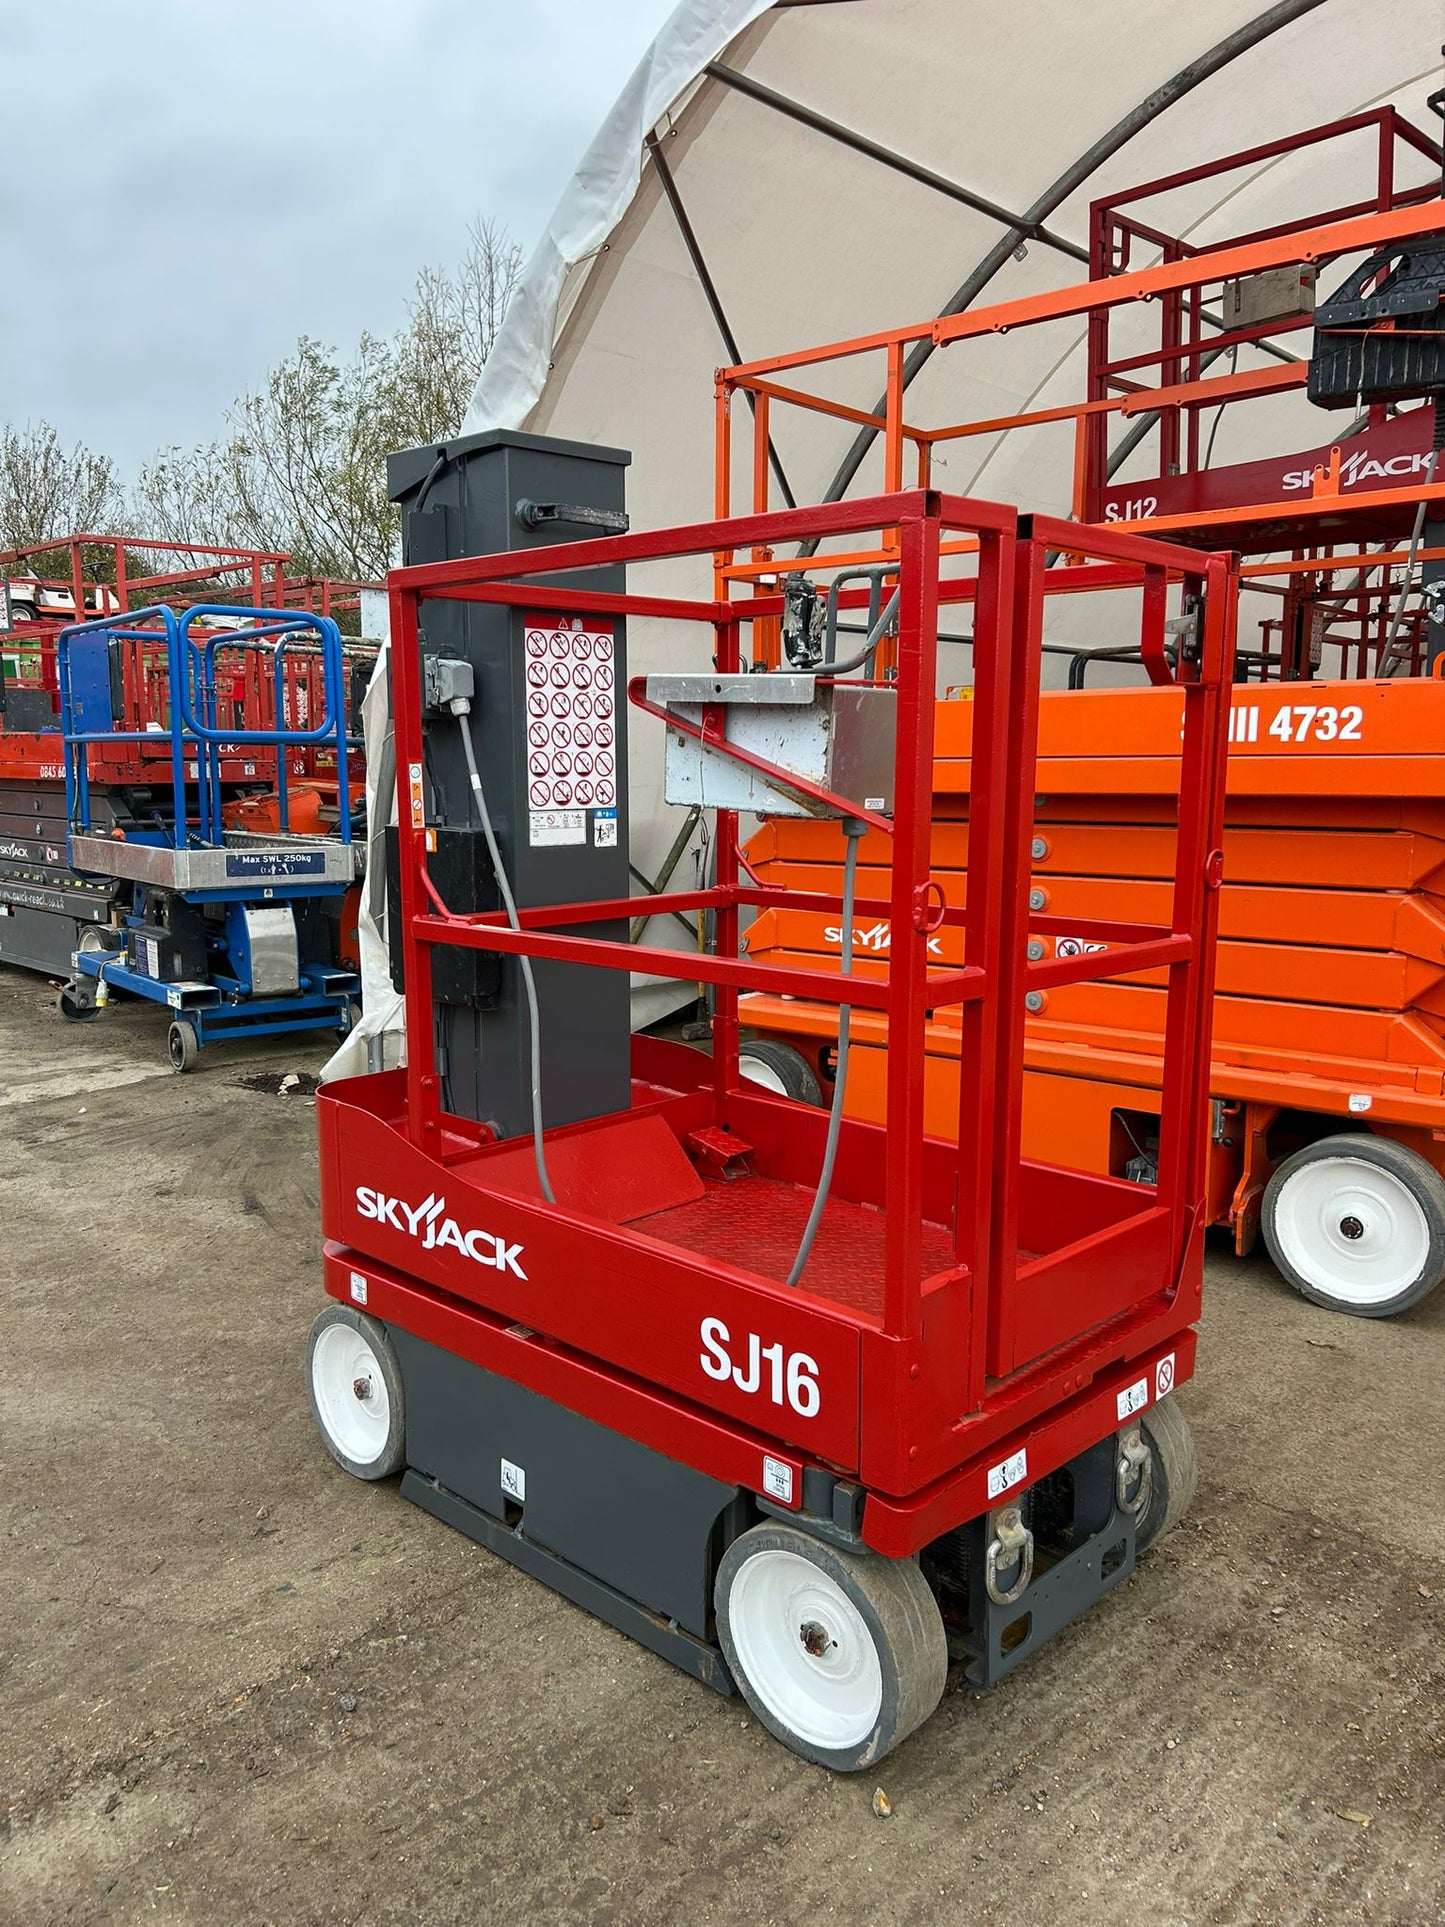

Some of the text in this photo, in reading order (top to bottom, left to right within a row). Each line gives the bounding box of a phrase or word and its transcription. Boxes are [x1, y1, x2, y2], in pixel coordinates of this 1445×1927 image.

[1105, 497, 1158, 525] SJ12
[1269, 706, 1363, 742] 4732
[40, 765, 57, 778] 0845
[0, 842, 29, 858] SKYJACK
[242, 854, 312, 864] Max SWL 250kg
[355, 1186, 529, 1281] SKYJACK
[700, 1317, 820, 1418] SJ16
